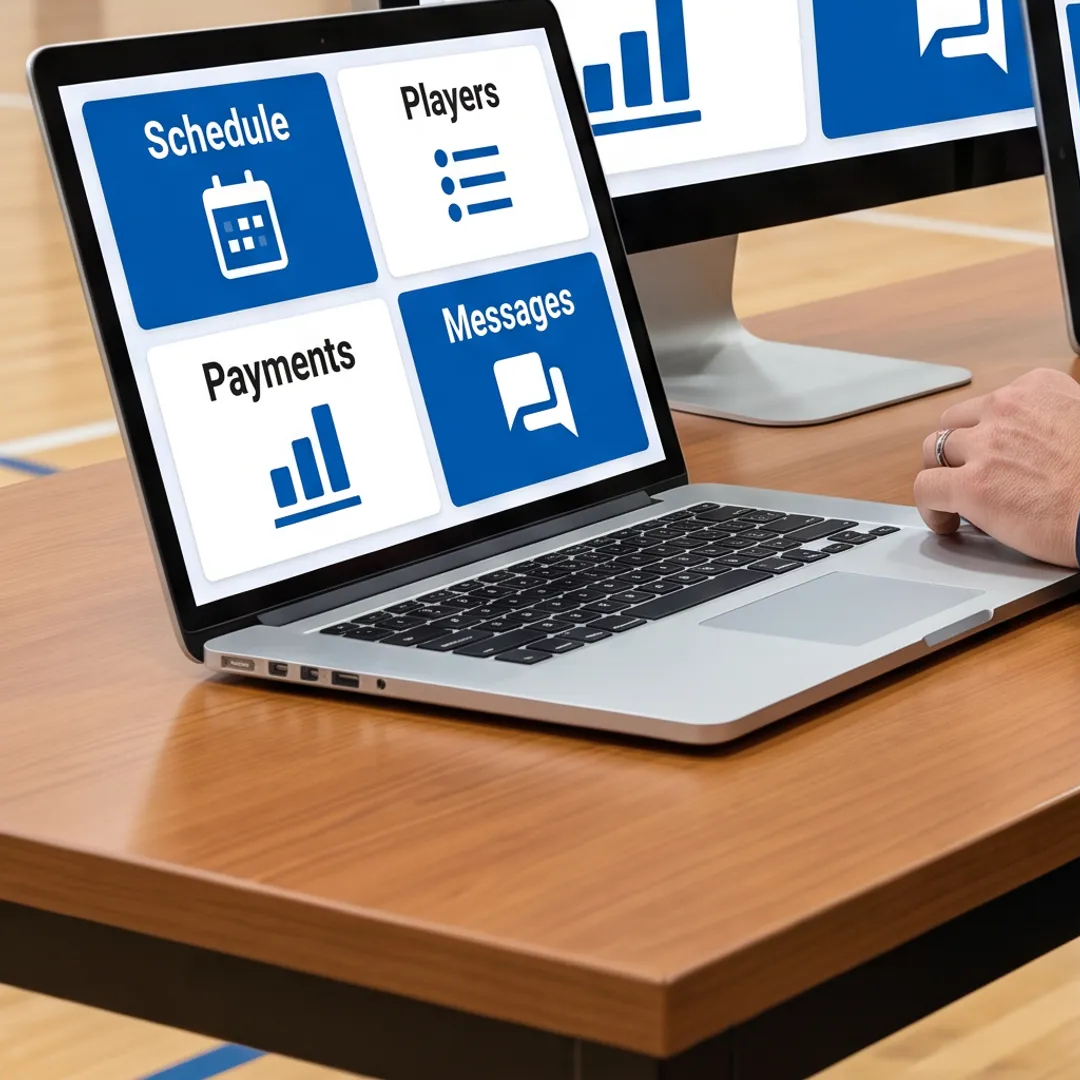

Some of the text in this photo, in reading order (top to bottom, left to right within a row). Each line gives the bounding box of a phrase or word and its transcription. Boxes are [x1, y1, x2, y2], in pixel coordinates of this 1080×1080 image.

[143, 103, 291, 160] Schedule
[400, 82, 500, 124] Players
[441, 285, 575, 344] Messages
[201, 338, 356, 403] Payments
